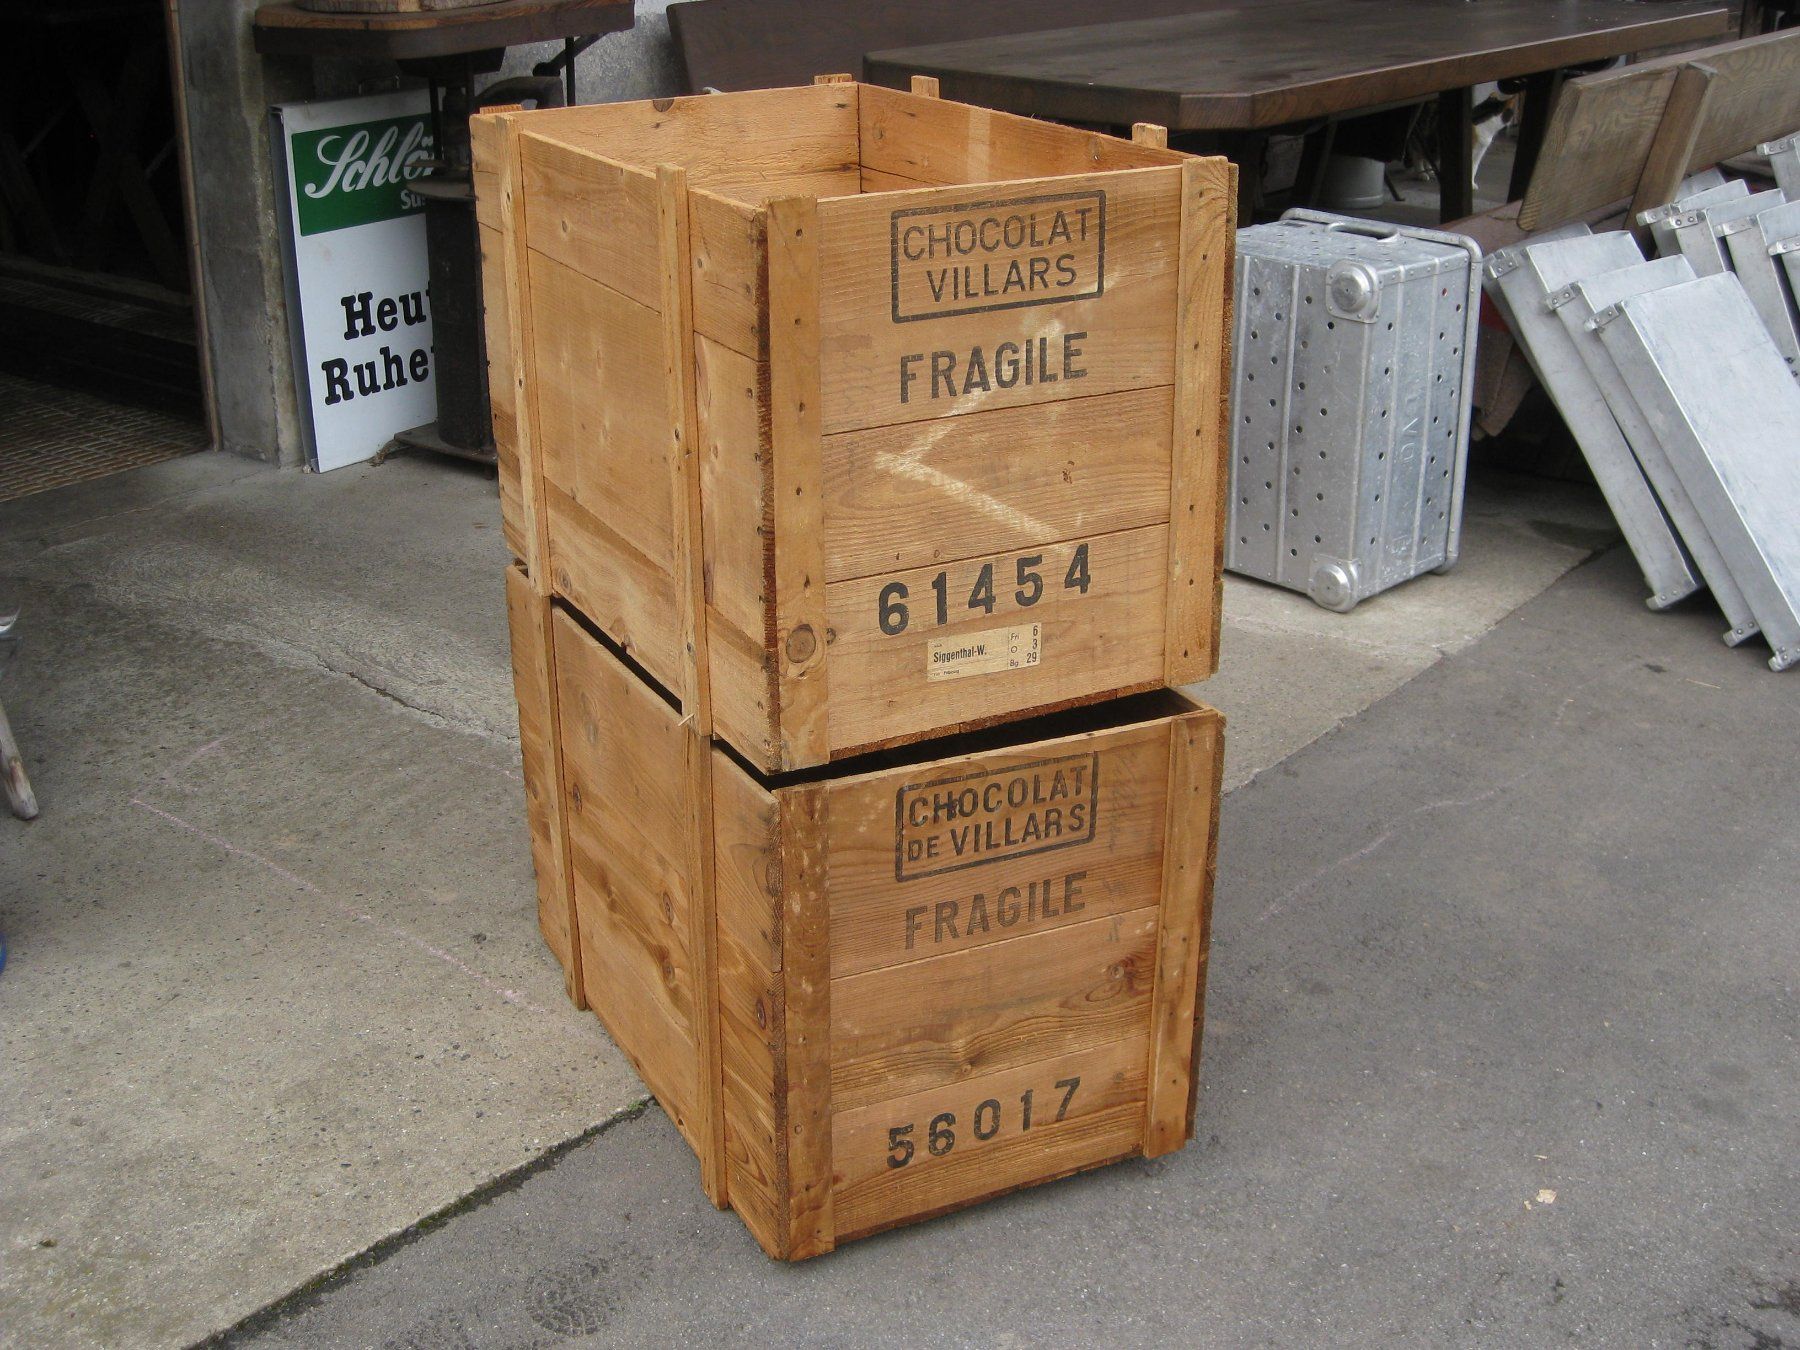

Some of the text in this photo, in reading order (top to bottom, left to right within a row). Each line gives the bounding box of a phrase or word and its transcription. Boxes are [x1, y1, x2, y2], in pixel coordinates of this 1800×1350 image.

[304, 121, 434, 199] Schlö
[903, 207, 1092, 261] CHOCOLAT
[926, 253, 1077, 302] VILLARS
[340, 288, 431, 341] Heu
[321, 346, 434, 405] Ruhe
[900, 331, 1088, 404] FRAGILE
[878, 543, 1091, 635] 61454
[1026, 651, 1037, 664] 29
[1032, 625, 1038, 637] 6
[1032, 638, 1038, 650] 3
[908, 765, 1088, 827] CHOCOLAT
[908, 803, 1085, 862] DE VILLARS
[905, 871, 1088, 950] FRAGILE
[887, 1076, 1081, 1169] 56017
